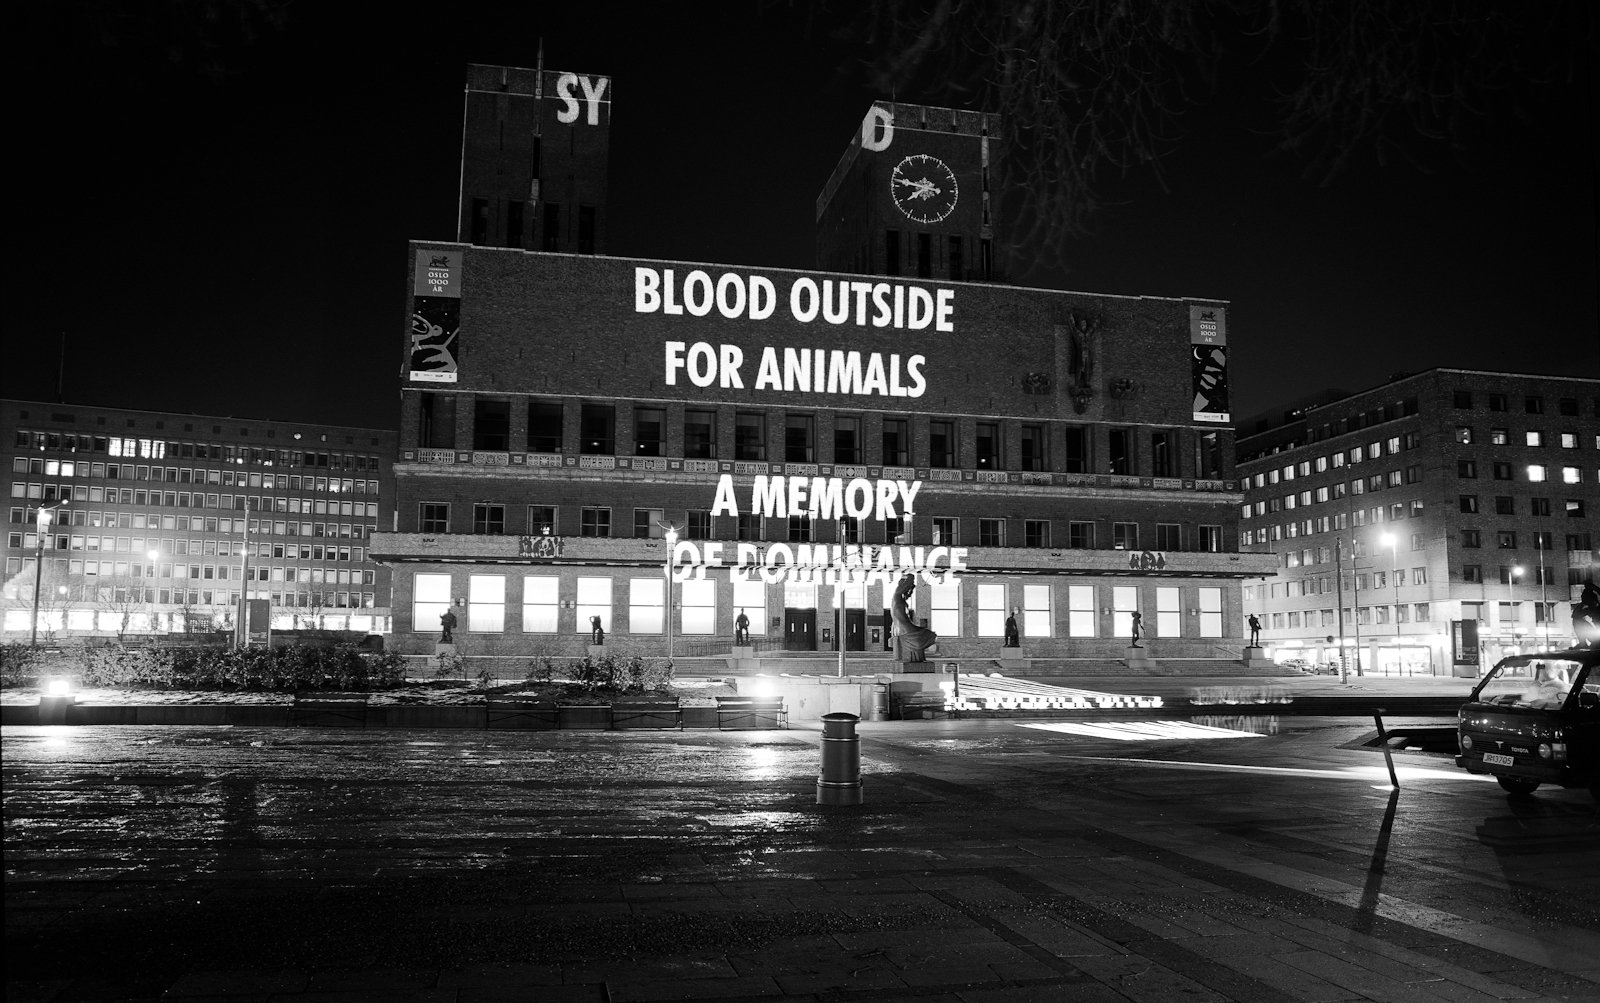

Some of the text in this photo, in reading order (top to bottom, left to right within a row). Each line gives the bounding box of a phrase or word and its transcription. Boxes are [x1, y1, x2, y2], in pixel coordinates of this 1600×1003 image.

[428, 271, 449, 279] OSLO
[635, 266, 955, 332] BLOOD OUTSIDE
[665, 341, 926, 398] FOR ANIMALS
[710, 474, 922, 522] A MEMORY
[664, 541, 969, 587] OF DOMINANCE
